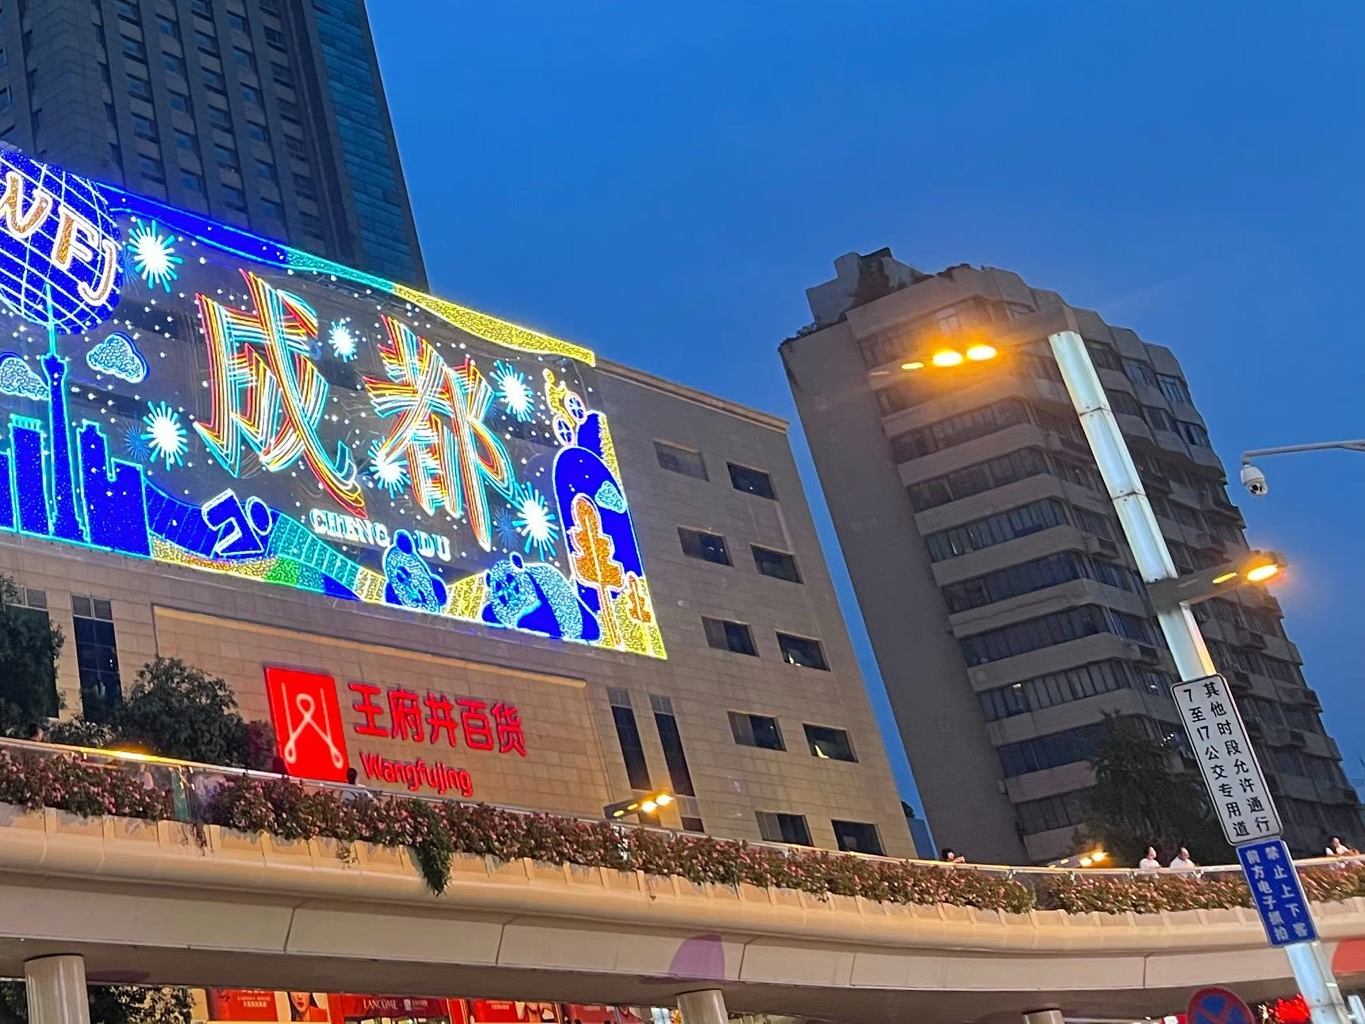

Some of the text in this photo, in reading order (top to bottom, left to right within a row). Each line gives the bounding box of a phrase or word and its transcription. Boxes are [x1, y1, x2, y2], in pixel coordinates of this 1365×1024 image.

[192, 268, 518, 552] 成都
[309, 508, 452, 562] CHENG DU
[348, 682, 528, 757] 王府井百货
[360, 751, 474, 797] Wangfujing
[1183, 688, 1251, 837] 7至17公交专用道
[1203, 681, 1270, 833] 其他时段允许通行
